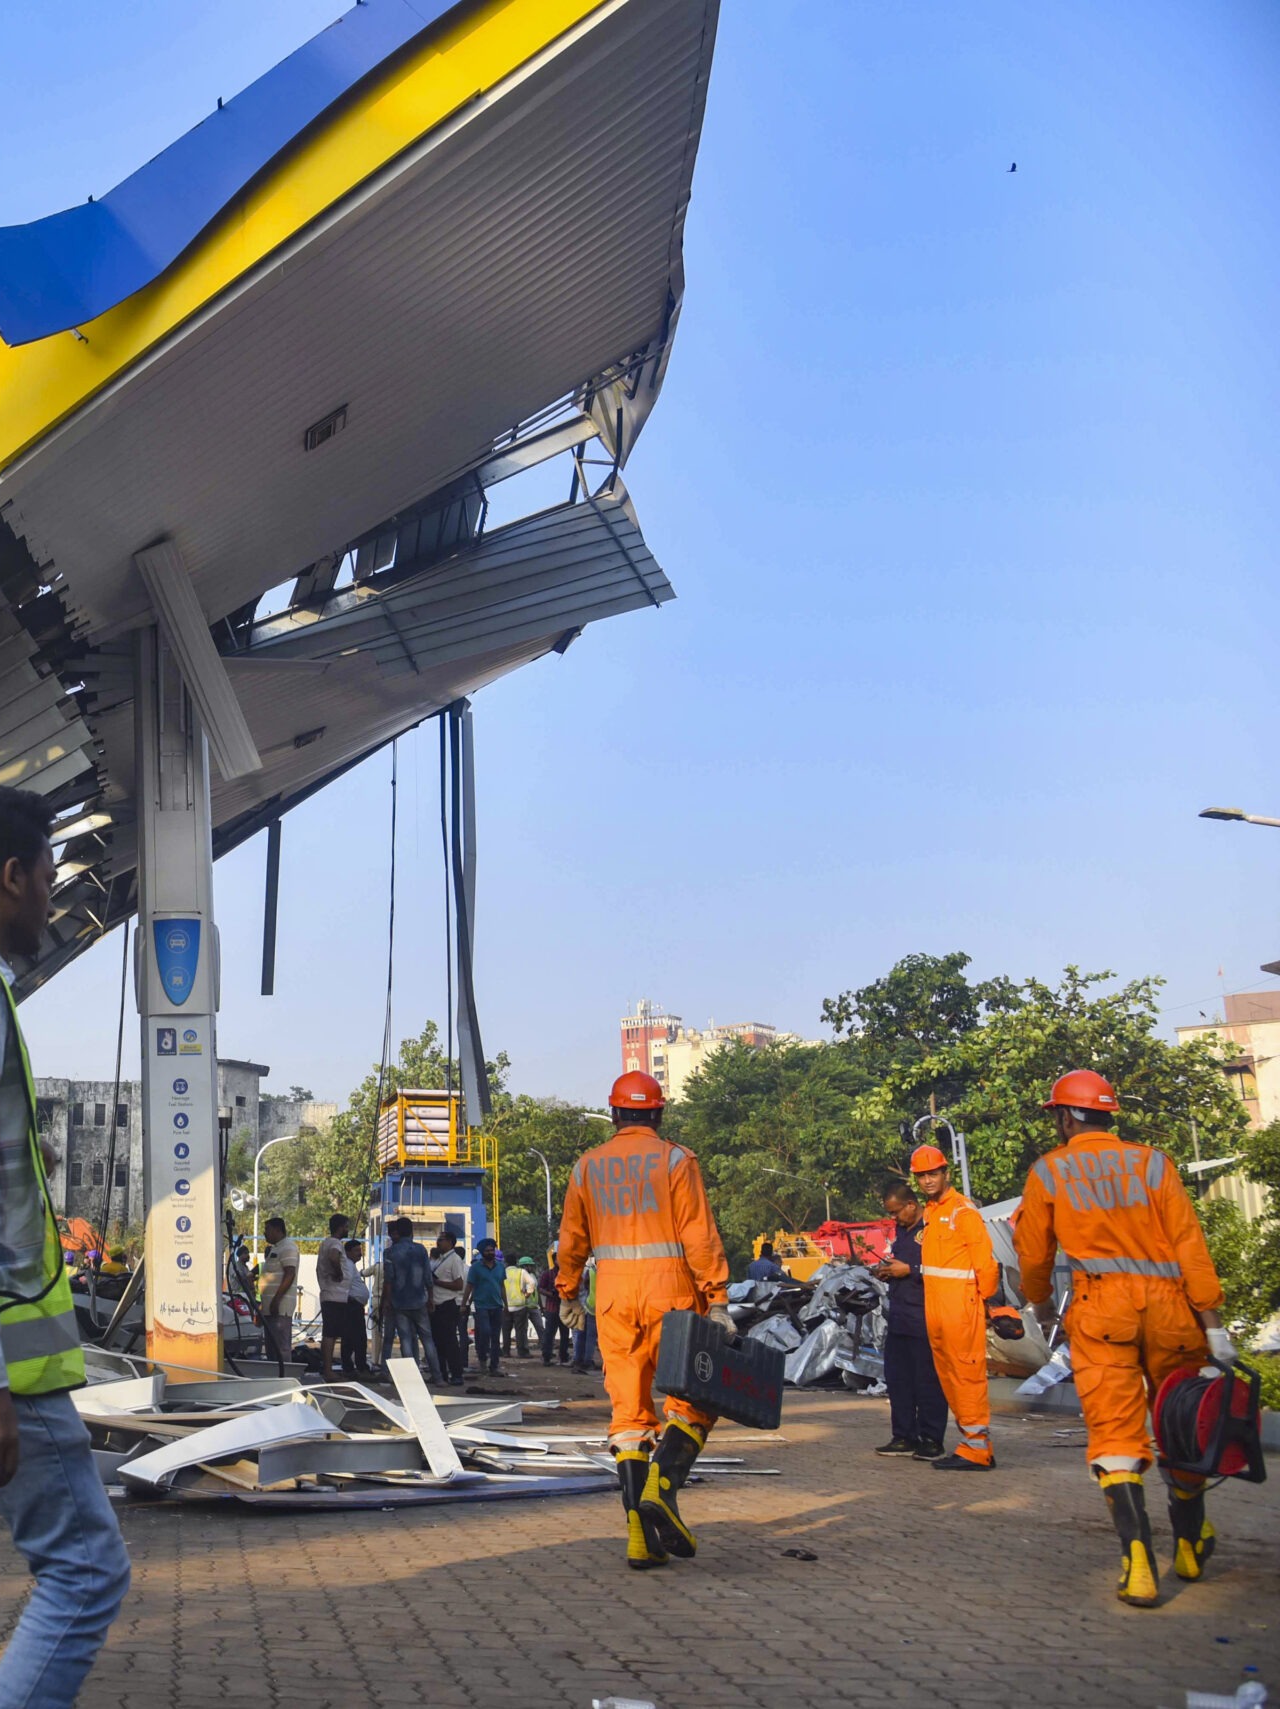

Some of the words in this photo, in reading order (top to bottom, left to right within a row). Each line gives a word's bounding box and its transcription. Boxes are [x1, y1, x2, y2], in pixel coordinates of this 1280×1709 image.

[588, 1153, 661, 1187] NDRF
[1053, 1149, 1141, 1180] NDRF
[592, 1181, 659, 1217] INDIA
[1064, 1175, 1149, 1211] INDIA
